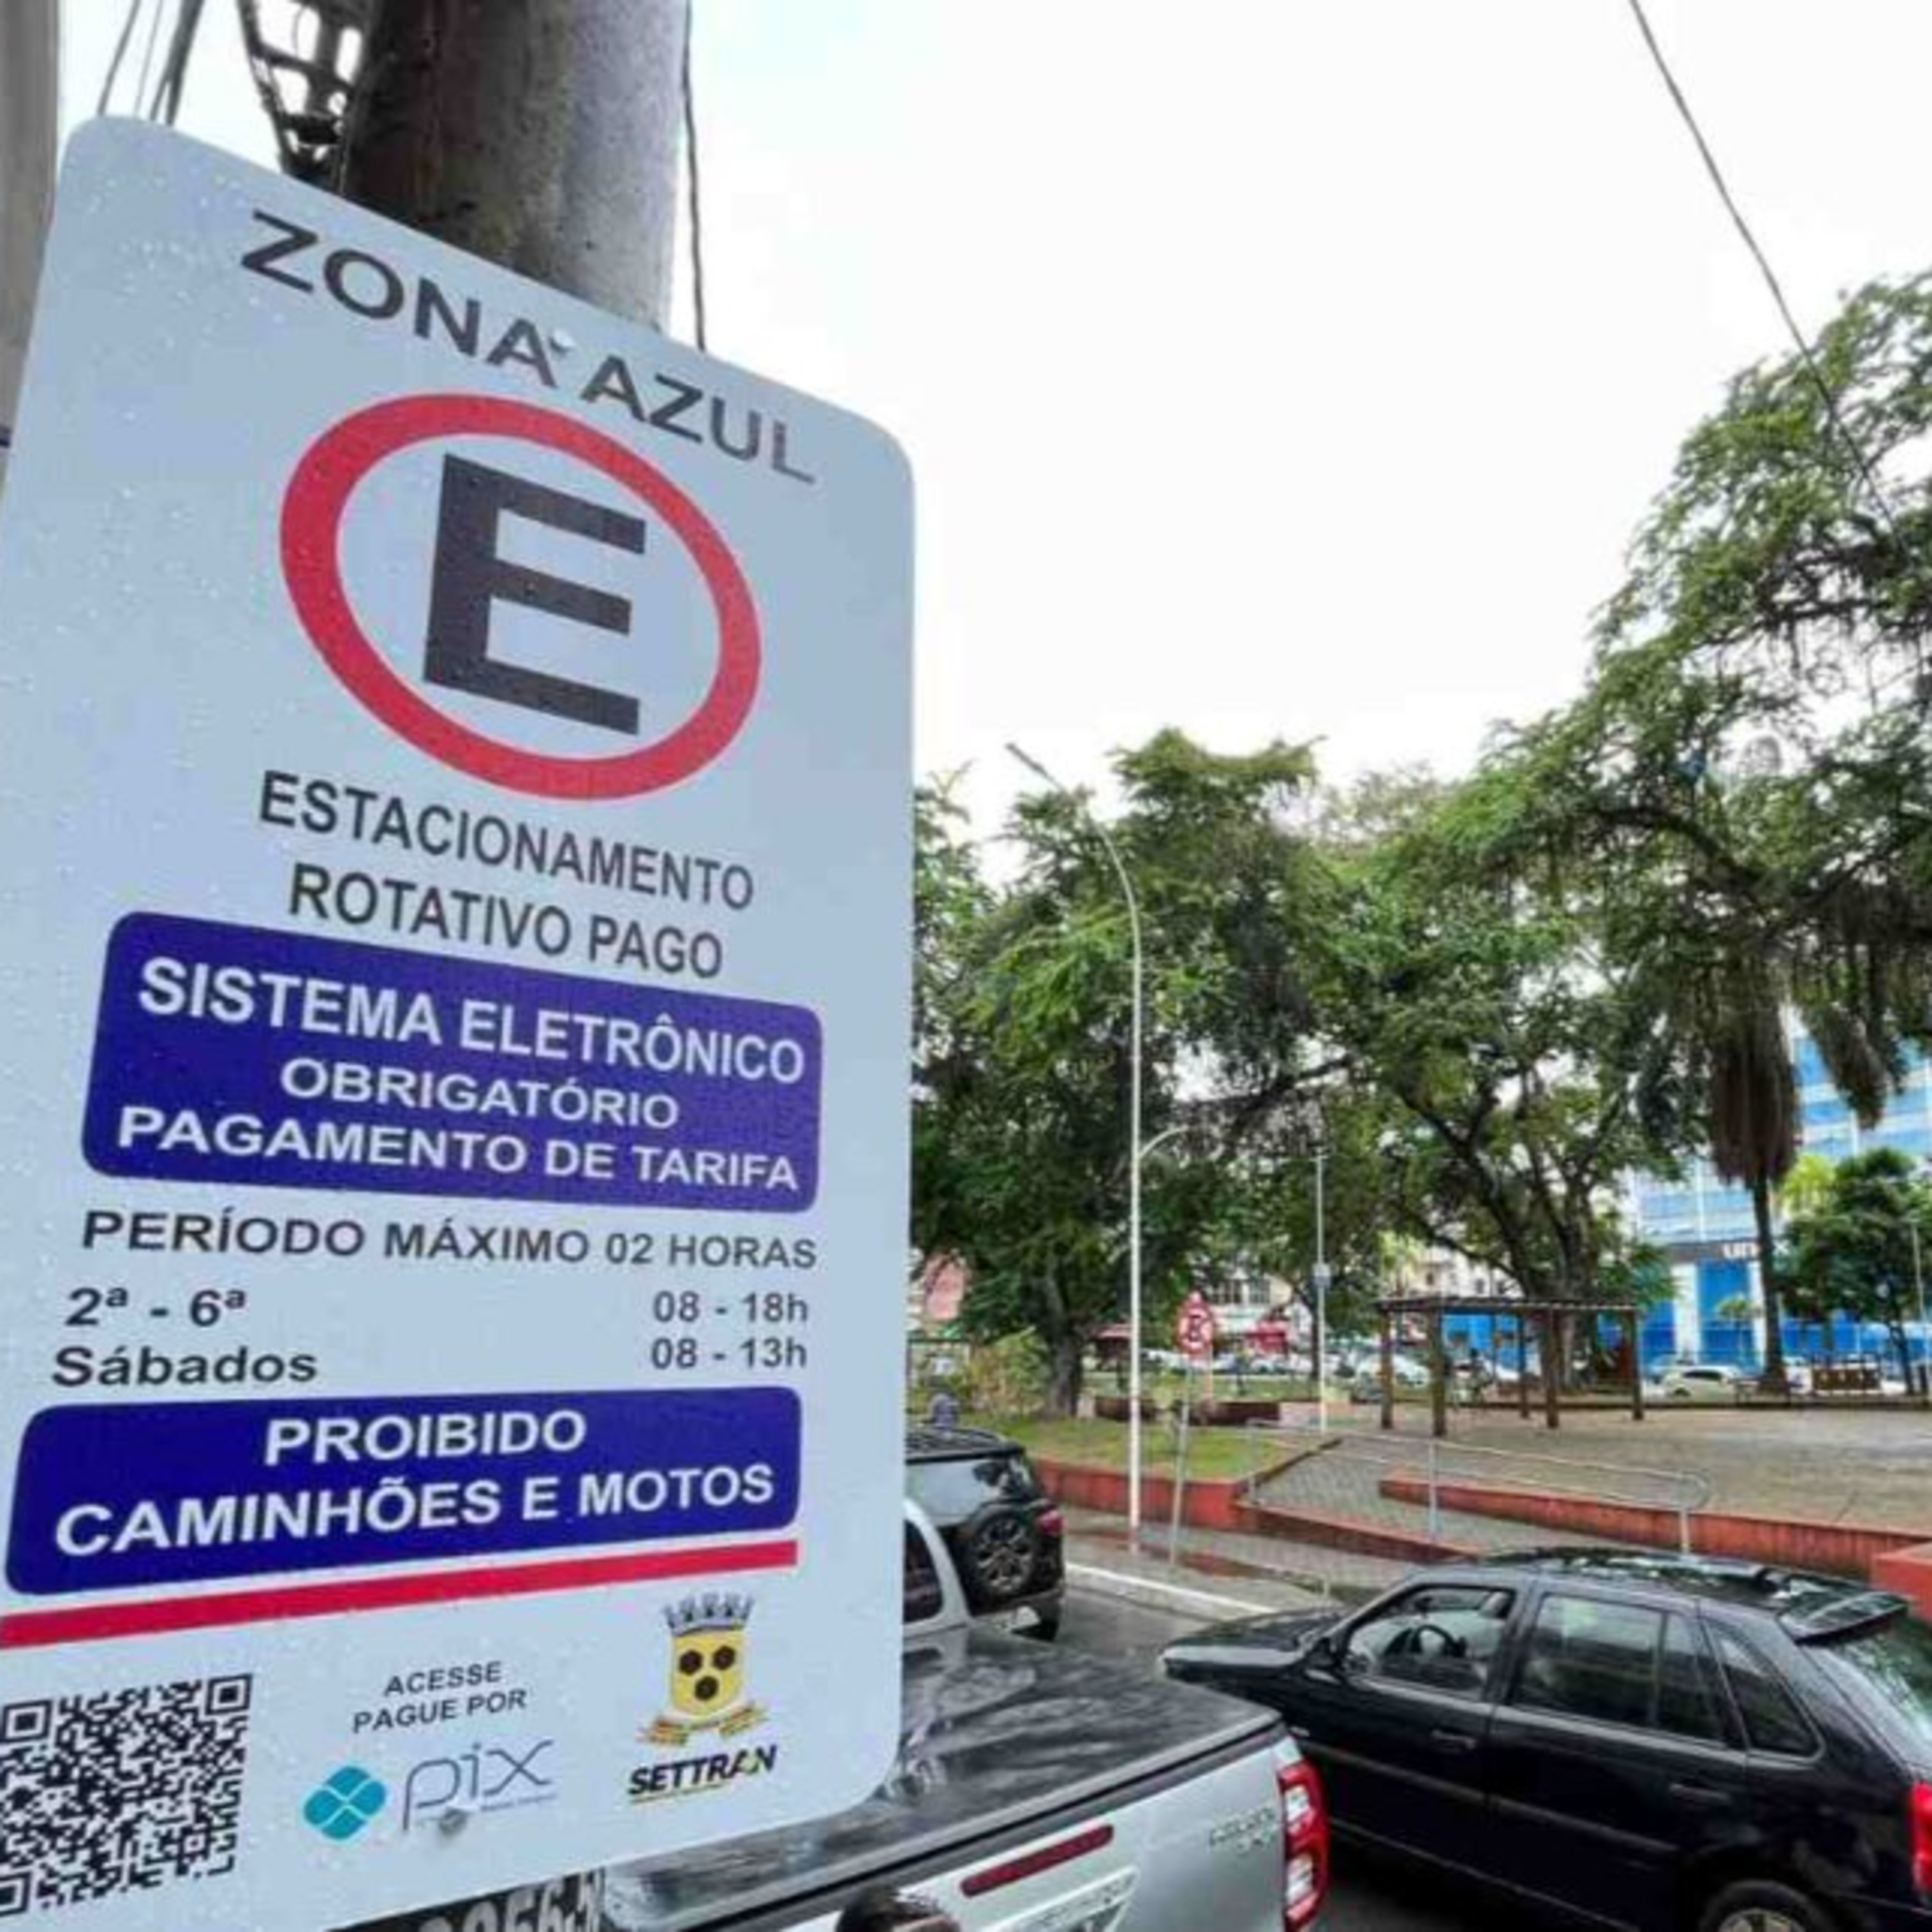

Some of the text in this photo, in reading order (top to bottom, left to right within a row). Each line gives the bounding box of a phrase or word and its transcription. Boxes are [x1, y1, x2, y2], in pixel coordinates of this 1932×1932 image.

[240, 209, 817, 486] ZONA AZUL
[422, 452, 647, 736] E
[259, 770, 755, 911] ESTACIONAMENTO
[290, 862, 724, 979] ROTATIVO PAGO
[139, 957, 805, 1084] SISTEMA ELETRÔNICO
[281, 1057, 680, 1130] OBRIGATÓRIO
[117, 1105, 799, 1191] PAGAMENTO DE TARIFA
[81, 1206, 818, 1270] PERÍODO MÁXIMO 02 HORAS
[652, 1292, 701, 1323] 08
[743, 1292, 810, 1323] 18h
[53, 1345, 318, 1387] Sábados
[650, 1338, 699, 1369] 08
[742, 1337, 809, 1368] 13h
[264, 1409, 587, 1466] PROIBIDO
[54, 1463, 777, 1557] CAMINHÕES E MOTOS
[352, 1689, 528, 1734] PAGUE POR
[383, 1660, 504, 1696] ACESSE
[627, 1744, 778, 1795] SETTRAN
